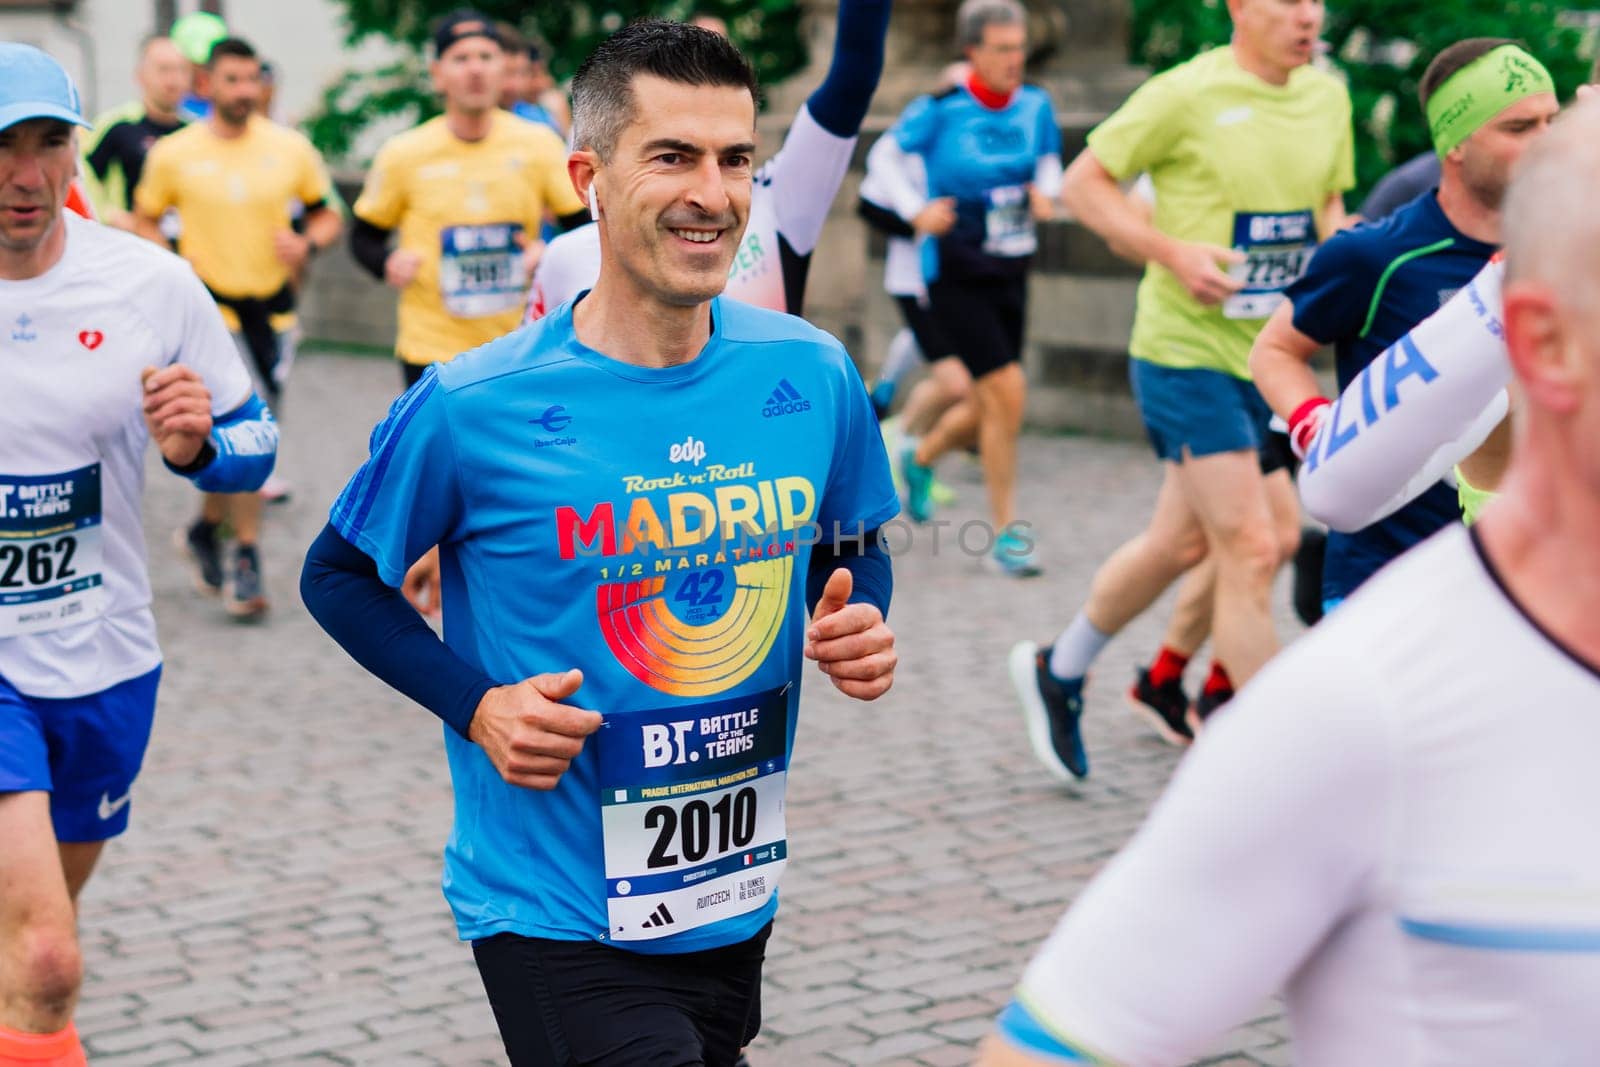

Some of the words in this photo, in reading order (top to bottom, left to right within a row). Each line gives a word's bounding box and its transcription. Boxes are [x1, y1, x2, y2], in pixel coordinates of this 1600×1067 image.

[762, 400, 811, 418] adidas
[669, 436, 706, 466] edp
[622, 472, 688, 494] Rock
[705, 461, 756, 482] Roll
[555, 476, 816, 560] MADRID
[655, 540, 796, 573] MARATHON
[674, 568, 725, 607] 42
[700, 708, 759, 736] BATTLE
[718, 732, 729, 740] OF
[729, 728, 745, 737] THE
[705, 733, 755, 760] TEAMS
[641, 786, 670, 799] PRAGUE
[670, 779, 718, 795] INTERNATIONAL
[718, 770, 746, 786] MARATHON
[644, 786, 757, 869] 2010
[770, 846, 778, 859] E
